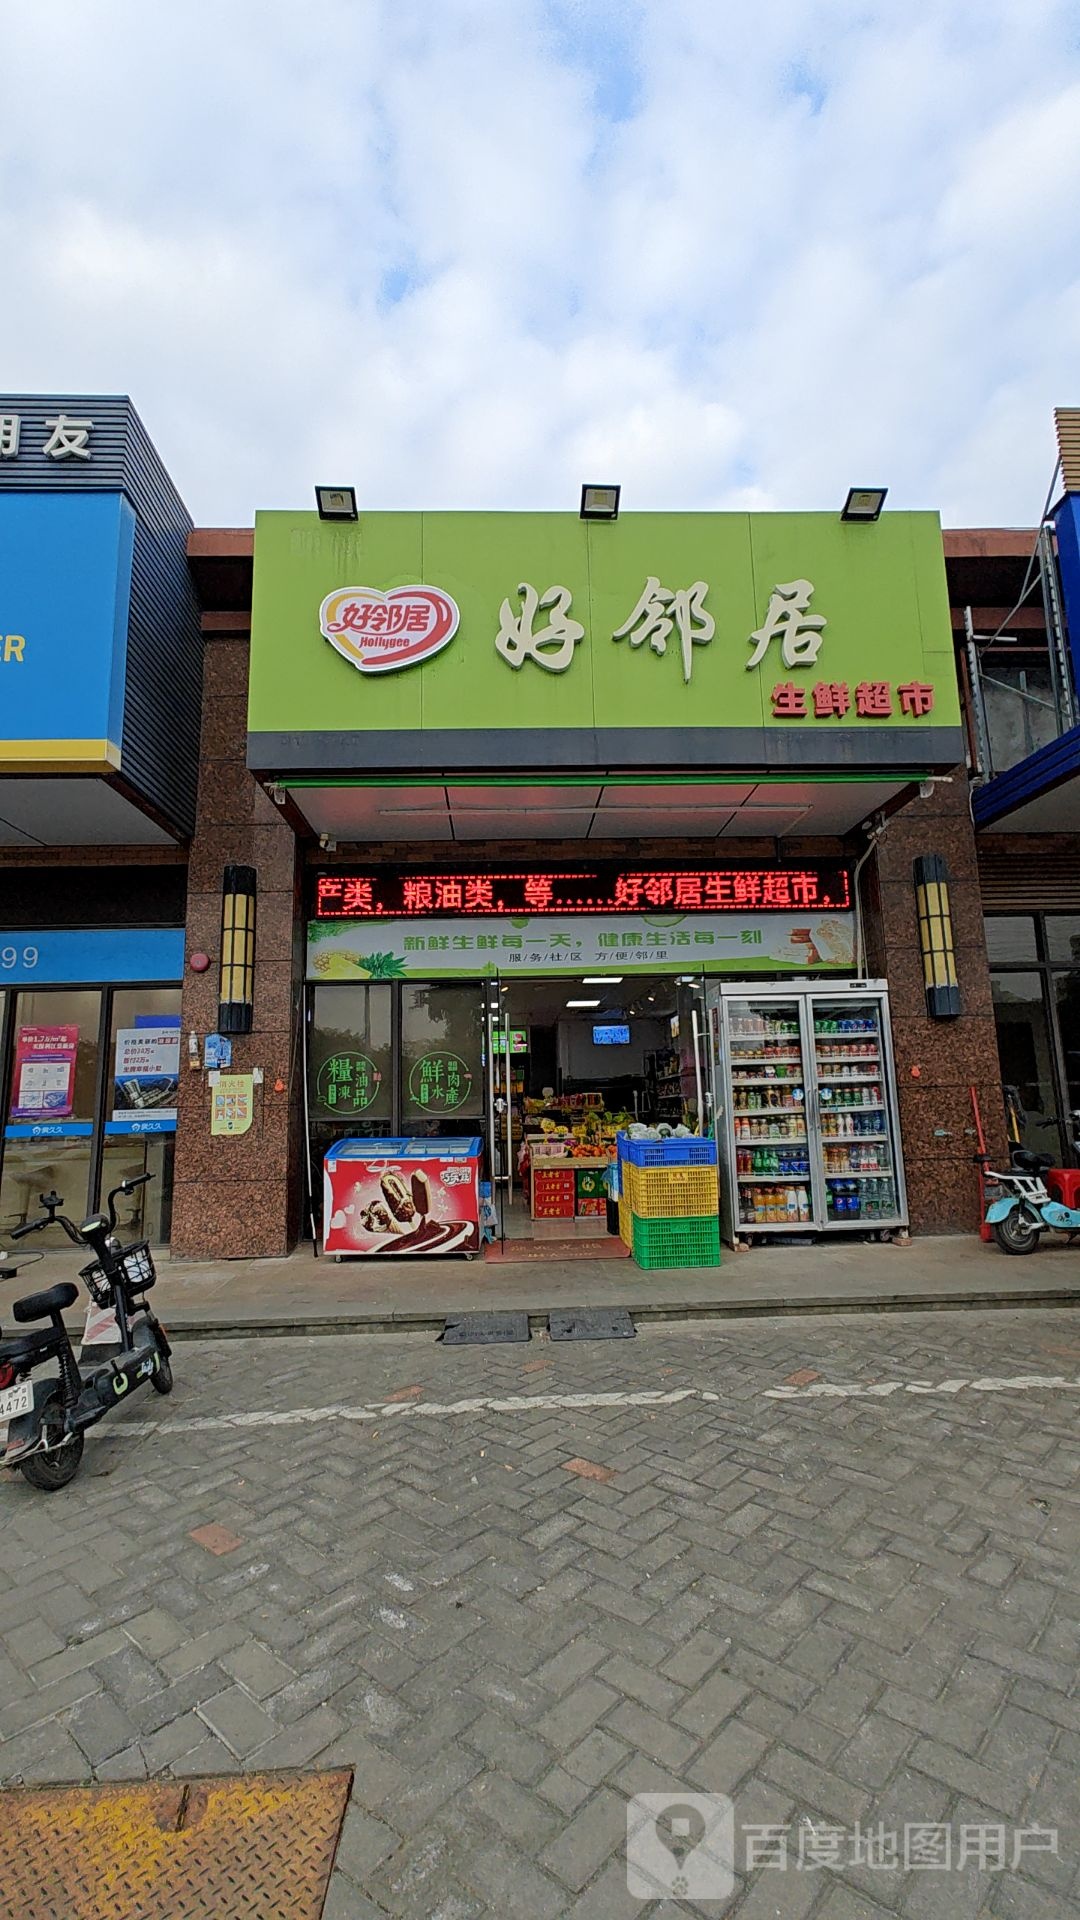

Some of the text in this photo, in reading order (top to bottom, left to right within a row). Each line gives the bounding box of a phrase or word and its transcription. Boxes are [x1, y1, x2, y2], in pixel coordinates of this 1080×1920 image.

[327, 602, 431, 636] 好邻居
[494, 576, 828, 684] 好邻居
[771, 680, 934, 718] 生鲜超市
